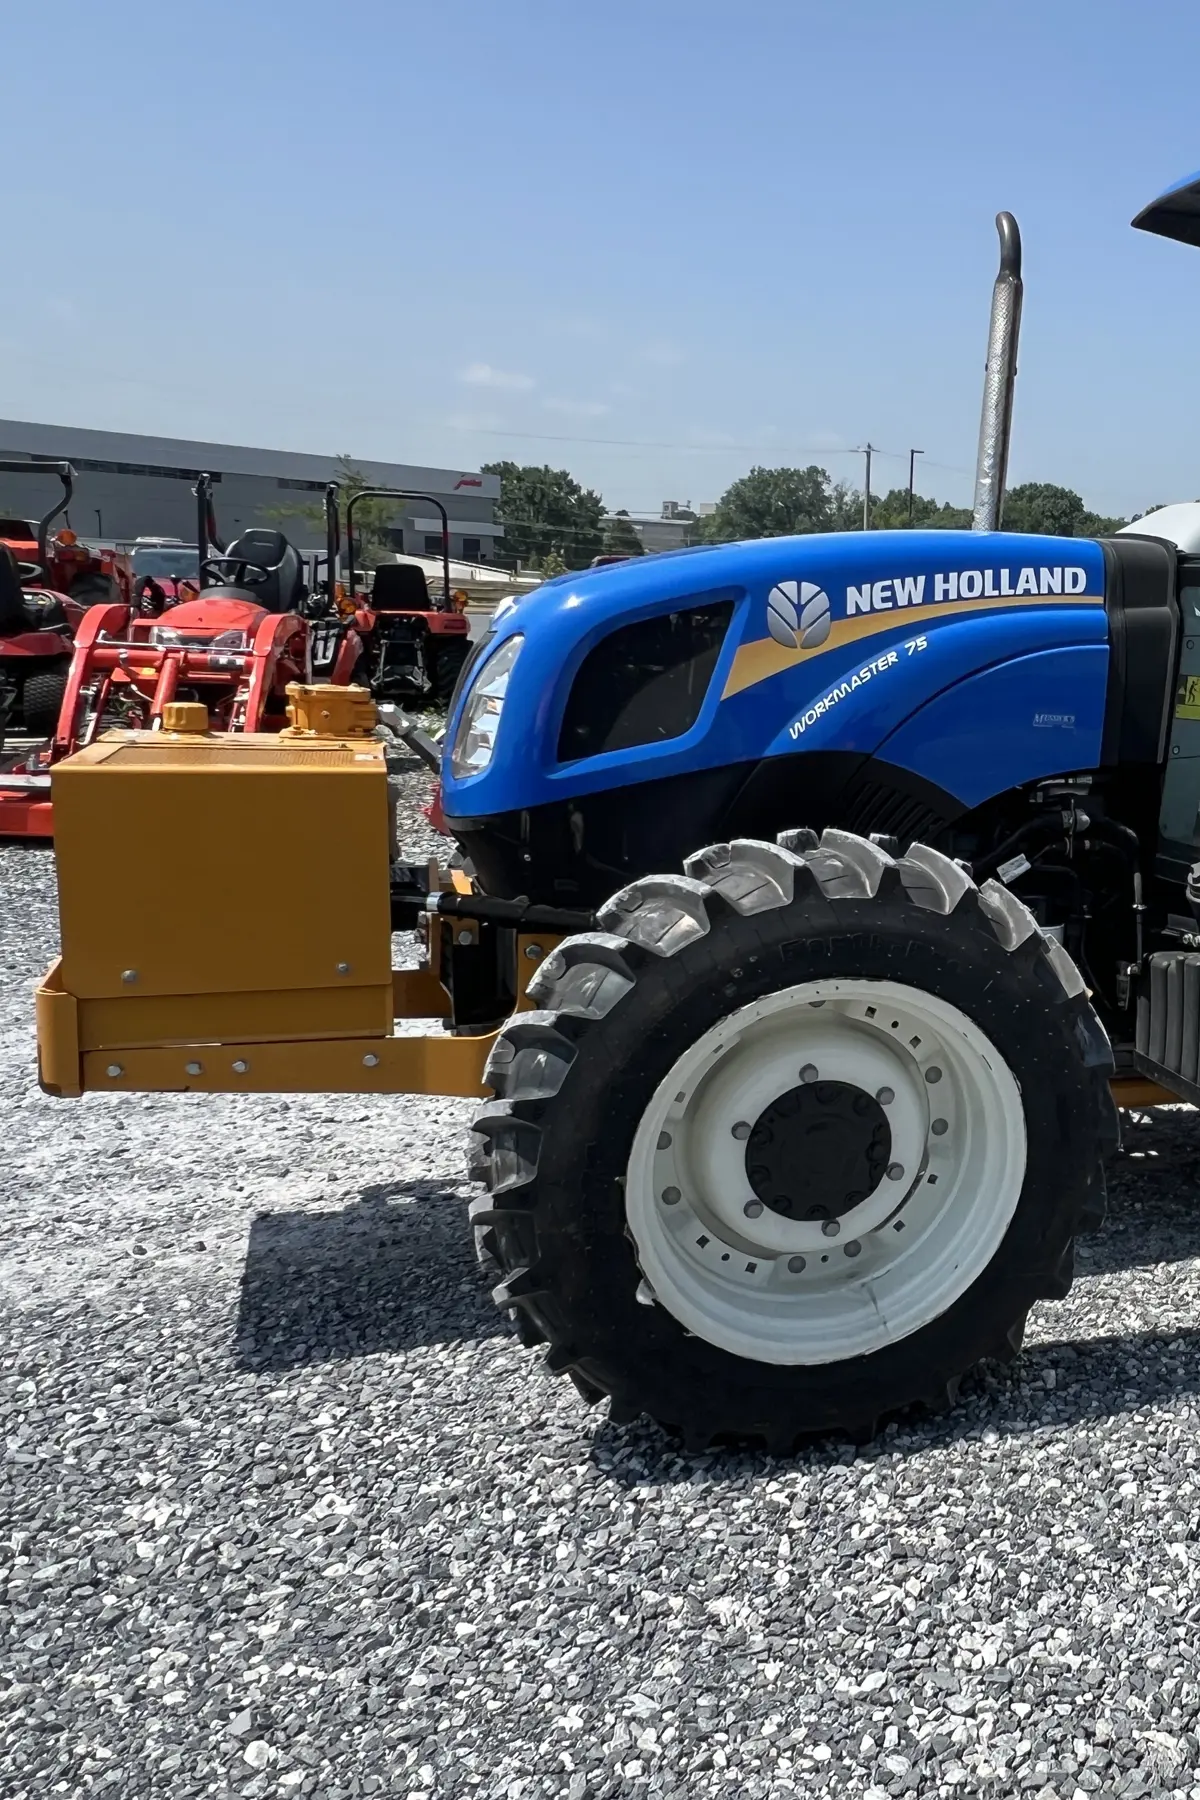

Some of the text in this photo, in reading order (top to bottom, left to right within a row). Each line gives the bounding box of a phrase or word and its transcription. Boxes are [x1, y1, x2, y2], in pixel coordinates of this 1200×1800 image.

[846, 567, 1087, 615] NEW HOLLAND
[789, 636, 928, 740] WORKMASTER 75
